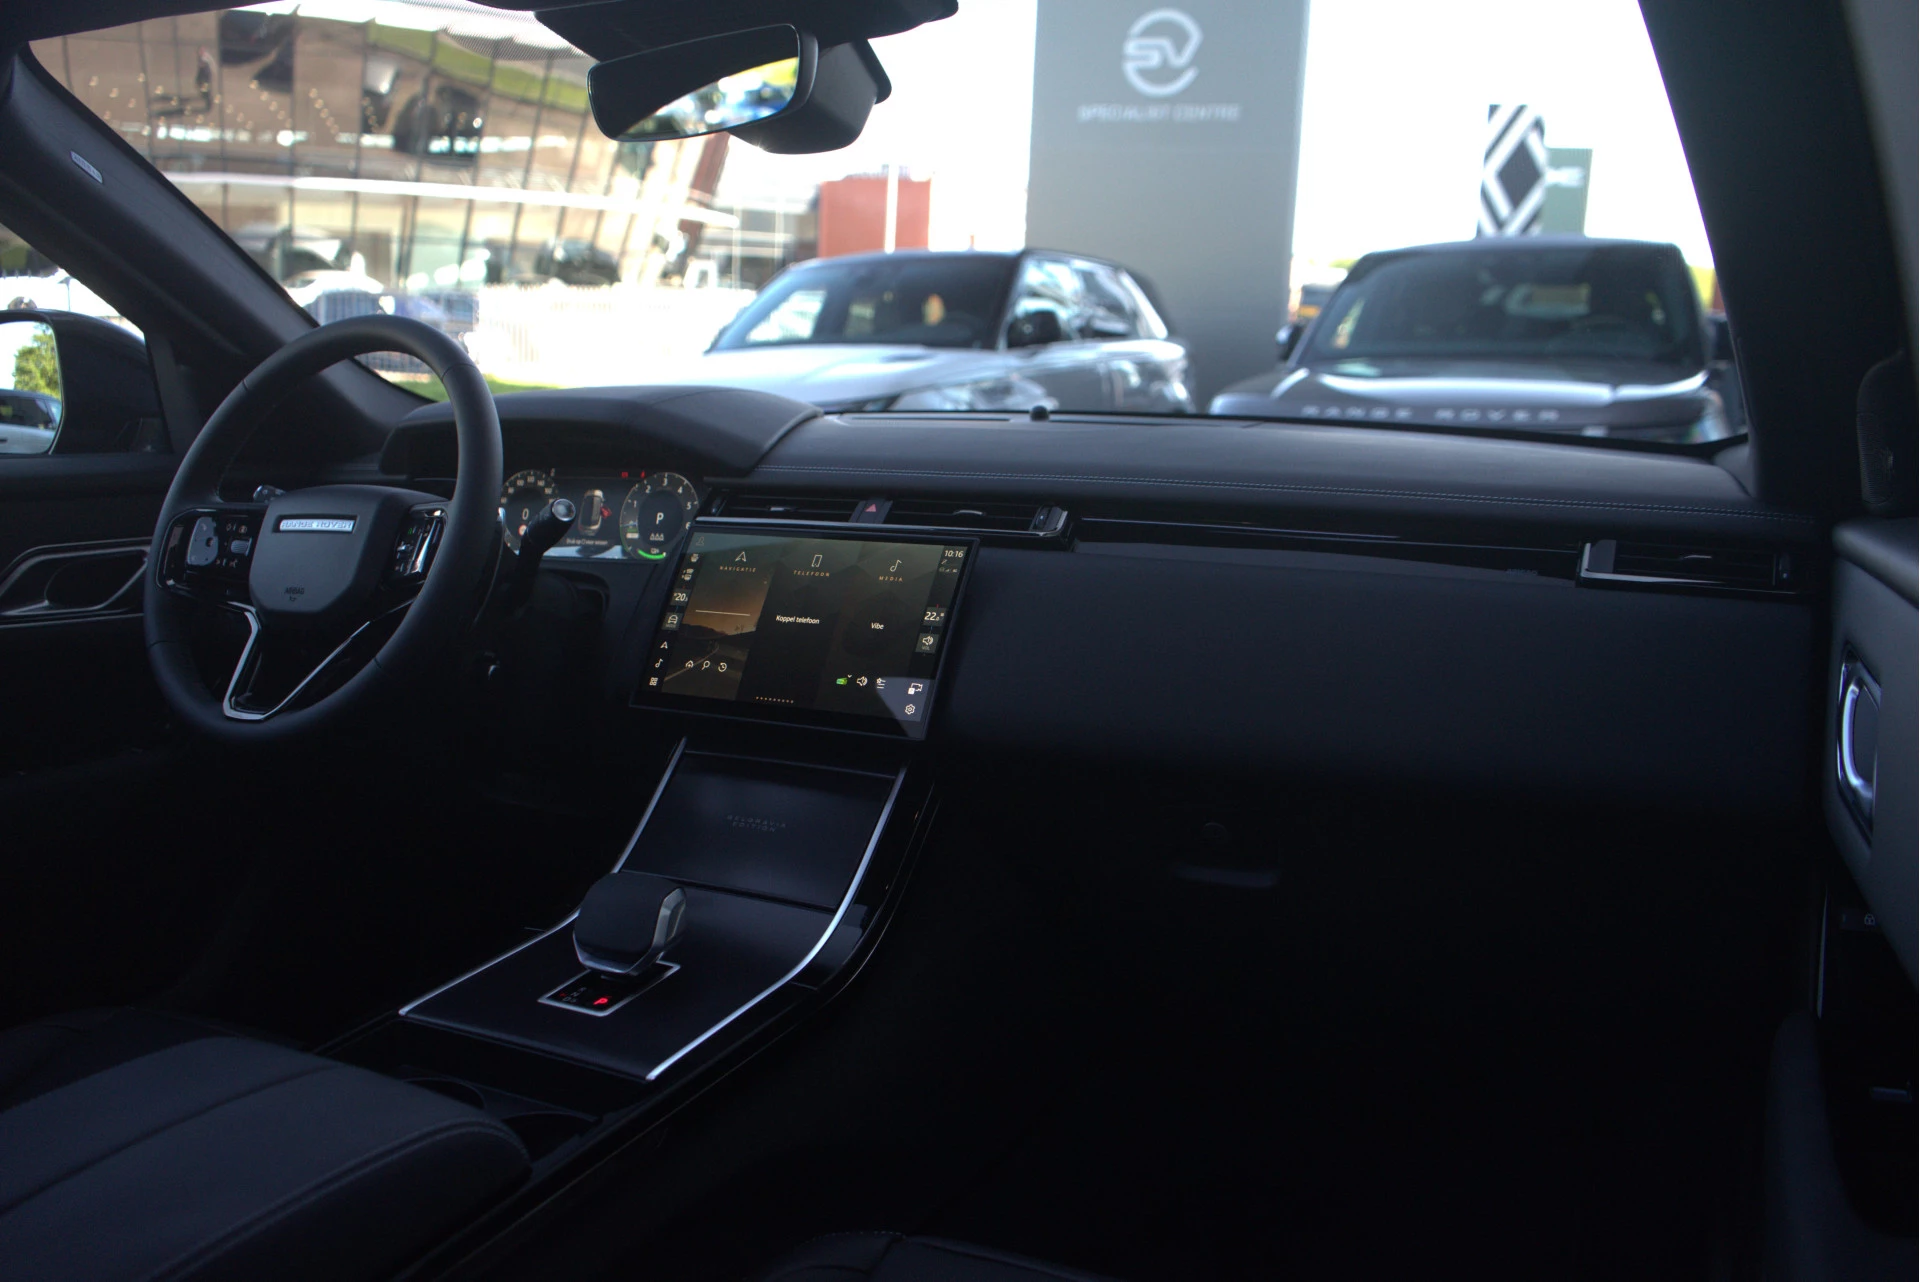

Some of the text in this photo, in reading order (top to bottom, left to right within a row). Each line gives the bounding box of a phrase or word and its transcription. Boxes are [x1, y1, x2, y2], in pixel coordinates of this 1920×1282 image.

[1299, 404, 1560, 422] RANGE ROVER
[645, 485, 651, 493] 2
[677, 486, 683, 494] 4
[656, 512, 664, 525] P
[944, 549, 964, 558] 10:16
[719, 565, 757, 573] NAVIGATIE
[793, 569, 830, 577] TELEFOON
[878, 575, 904, 583] MEDIA
[776, 614, 820, 625] Koppel telefoon
[871, 622, 885, 630] Vibe
[593, 996, 609, 1006] P
